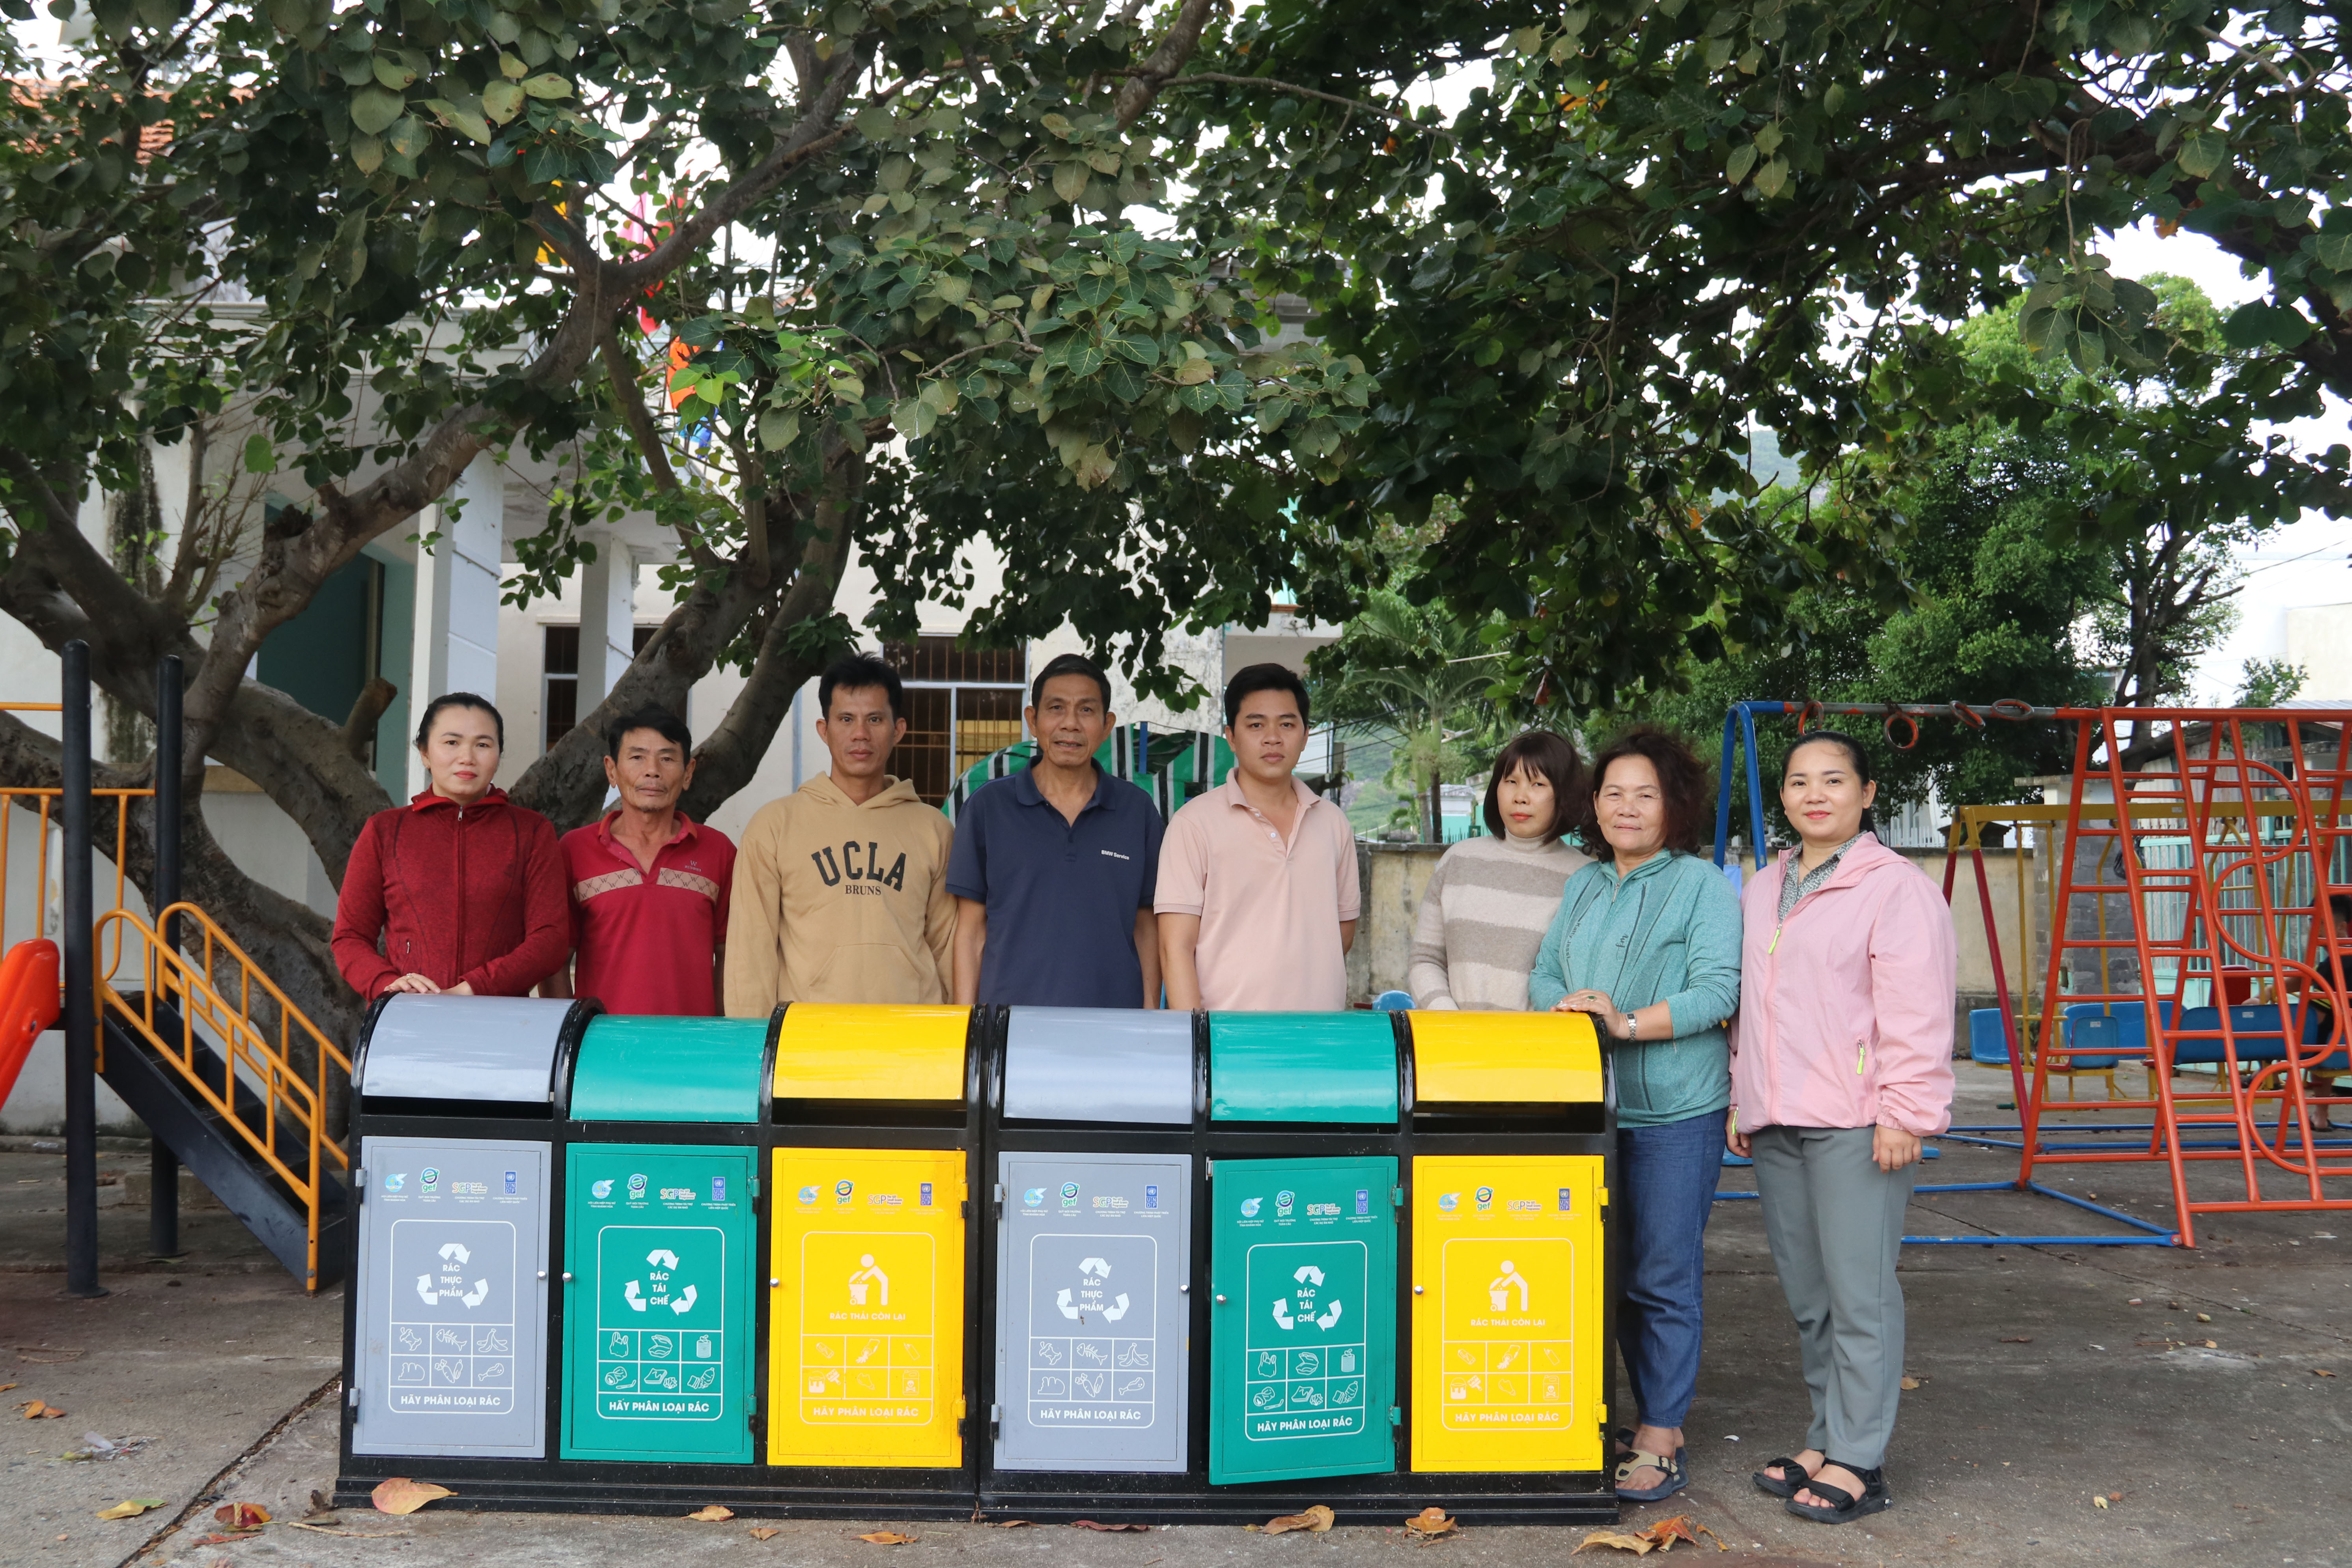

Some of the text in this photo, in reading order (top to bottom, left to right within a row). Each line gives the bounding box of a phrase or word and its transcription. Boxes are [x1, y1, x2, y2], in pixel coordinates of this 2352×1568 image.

[811, 841, 906, 892] UCLA
[845, 885, 881, 895] BRUNS
[423, 1184, 436, 1193] gef
[453, 1183, 471, 1193] SGP
[631, 1189, 644, 1198] gef
[661, 1189, 679, 1198] SGP
[837, 1196, 851, 1204] gef
[868, 1195, 886, 1204] SGP
[1063, 1198, 1076, 1206] gef
[1094, 1197, 1111, 1207] SGP
[1308, 1205, 1325, 1214] SGP
[1477, 1202, 1490, 1211] gef
[1508, 1201, 1525, 1210] SGP
[1279, 1207, 1291, 1216] gef
[443, 1263, 460, 1272] RÁC
[441, 1275, 462, 1286] THỰC
[650, 1270, 669, 1281] RÁC
[1083, 1277, 1101, 1286] RÁC
[439, 1286, 463, 1297] PHẨM
[652, 1282, 666, 1292] TÁI
[1081, 1290, 1103, 1300] THỰC
[1297, 1287, 1316, 1298] RÁC
[650, 1294, 670, 1305] CHẾ
[1299, 1299, 1312, 1309] TÁI
[1080, 1300, 1103, 1311] PHẨM
[830, 1310, 906, 1322] RÁC THẢI CÒN LẠI
[1297, 1310, 1316, 1322] CHẾ
[1471, 1317, 1546, 1327] RÁC THẢI CÒN LẠI
[401, 1394, 501, 1407] HÃY PHÂN LOẠI RÁC
[632, 1400, 659, 1411] PHÂN
[663, 1403, 685, 1414] LOẠI
[688, 1401, 709, 1412] RÁC
[813, 1406, 919, 1419] HÃY PHÂN LOẠI RÁC
[1041, 1408, 1141, 1421] HÃY PHÂN LOẠI RÁC
[1455, 1411, 1559, 1424] HÃY PHÂN LOẠI RÁC
[1258, 1415, 1352, 1432] HÃY PHÂN LOẠI RÁC
